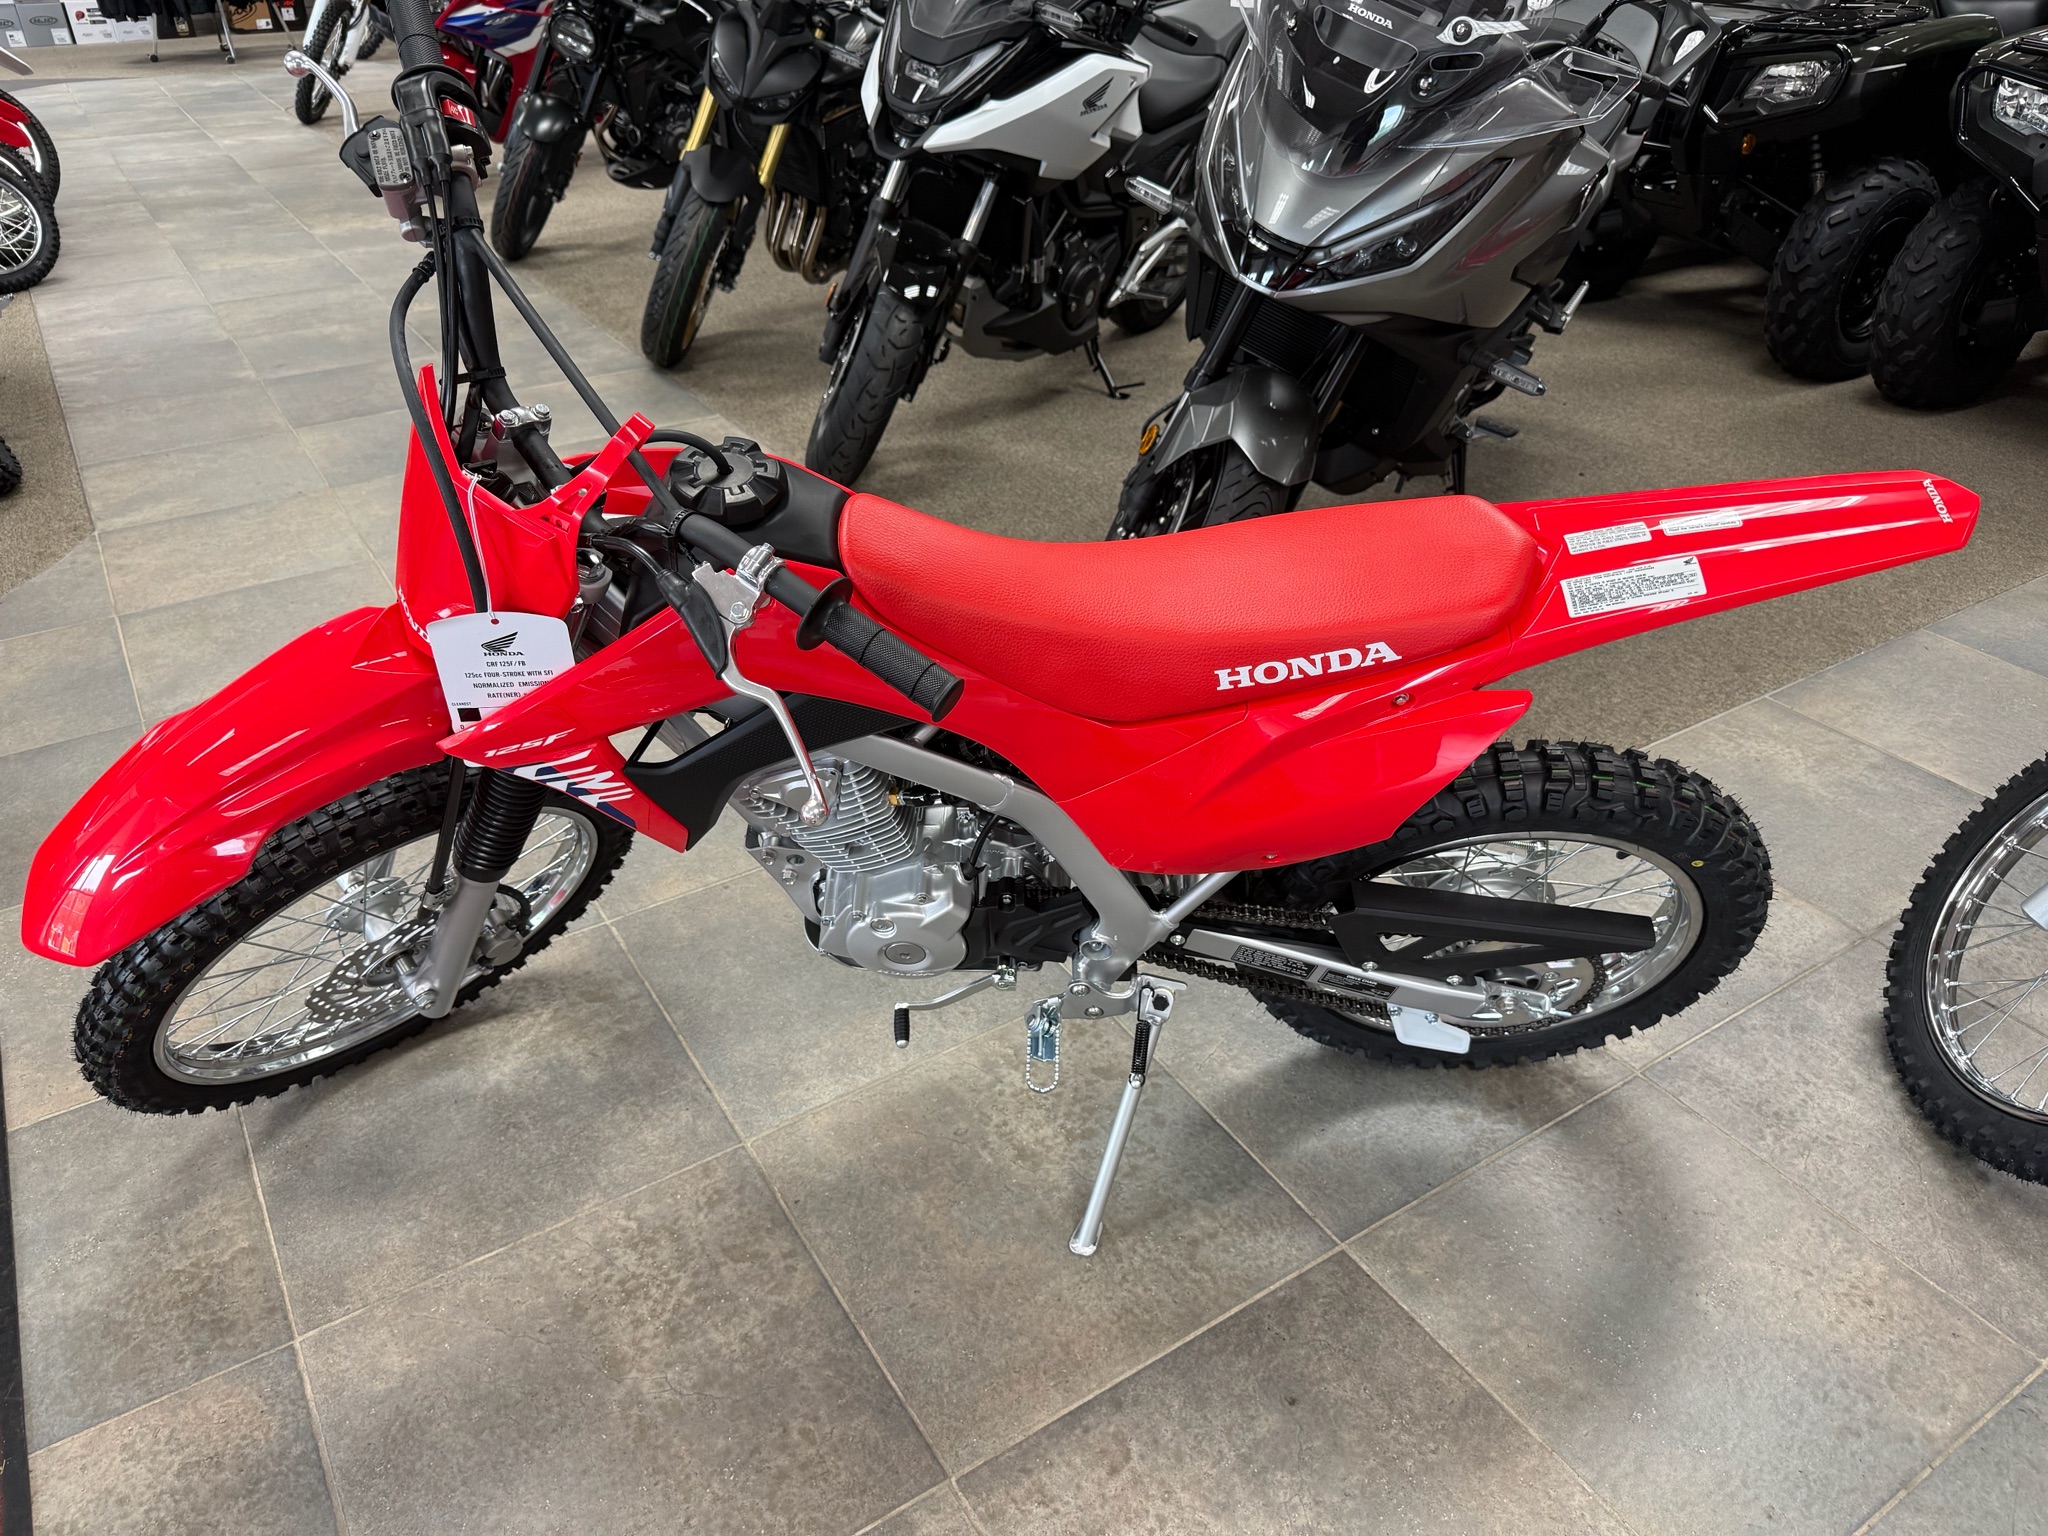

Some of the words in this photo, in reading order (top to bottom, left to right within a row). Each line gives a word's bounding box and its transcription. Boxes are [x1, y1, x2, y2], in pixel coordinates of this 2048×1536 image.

[1347, 3, 1393, 29] HONDA
[1923, 478, 1953, 523] HONDA
[398, 585, 431, 645] HOND
[484, 670, 525, 678] FOUR-STROKE
[1214, 641, 1402, 691] HONDA
[484, 728, 576, 758] 125F
